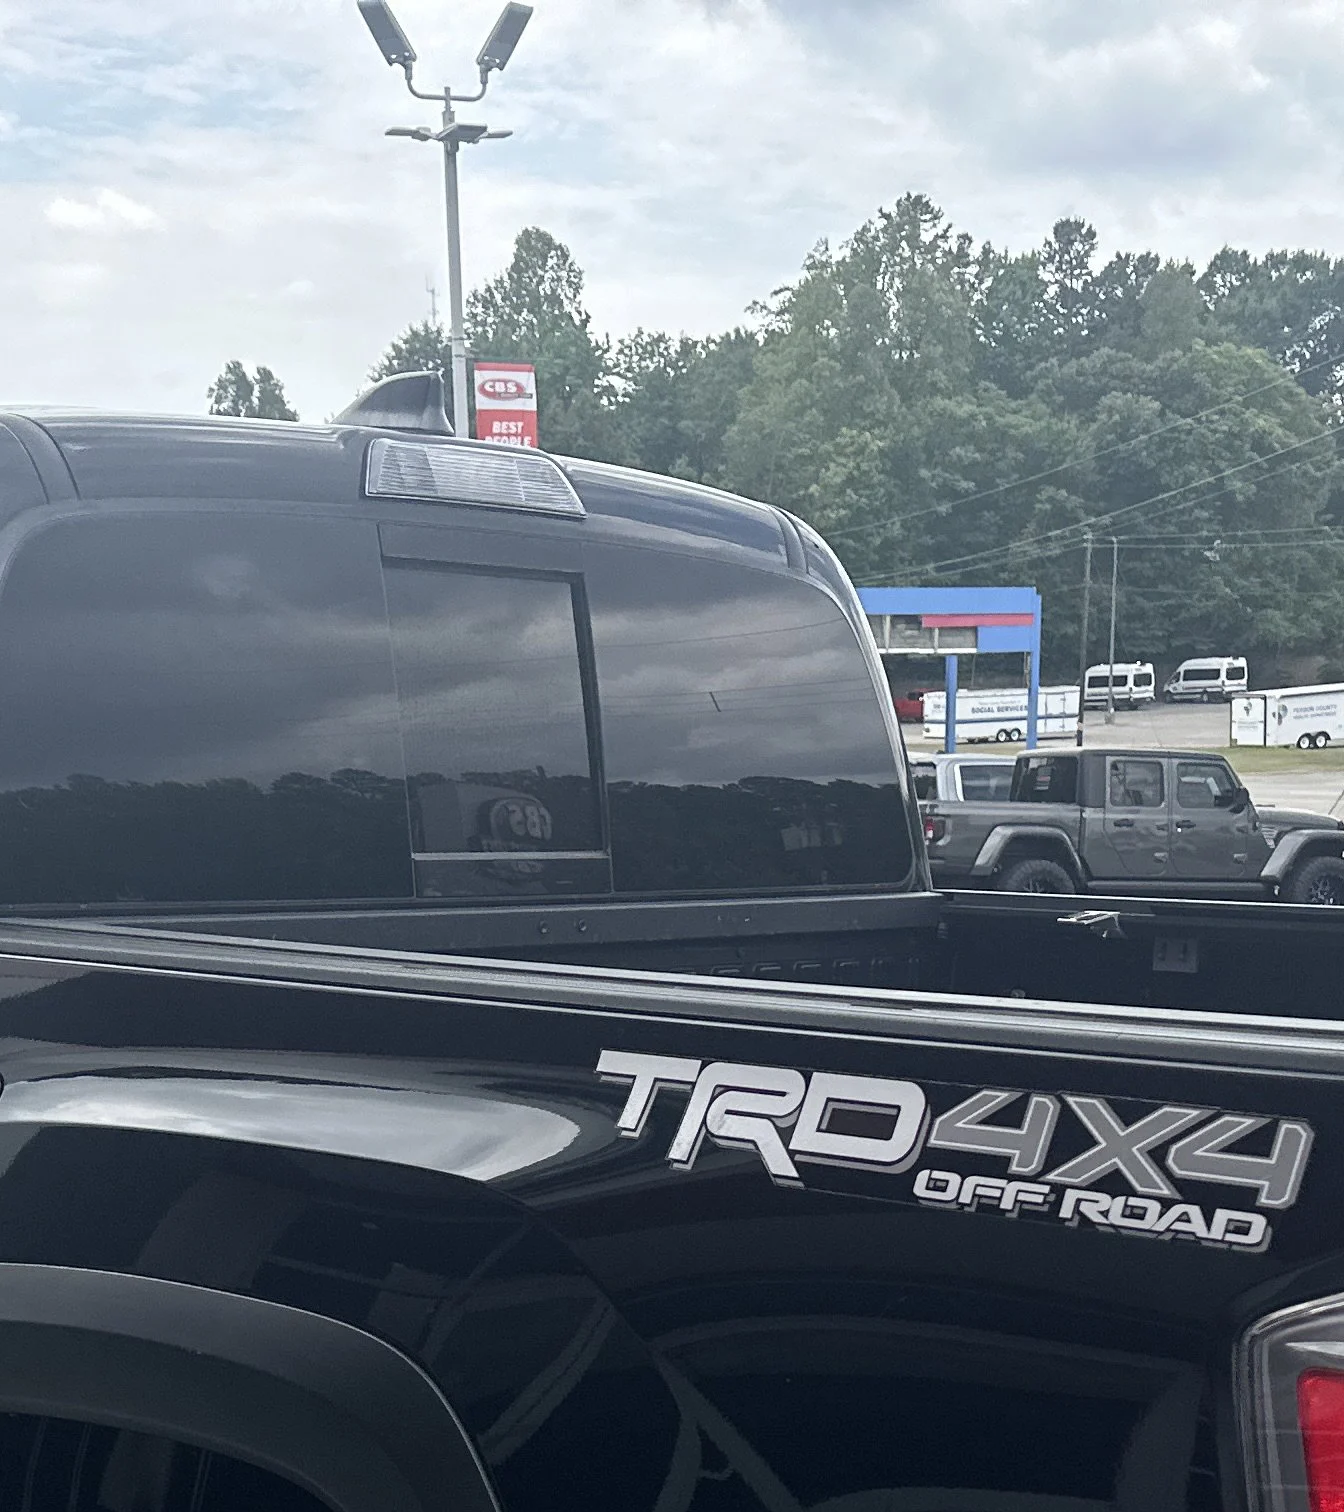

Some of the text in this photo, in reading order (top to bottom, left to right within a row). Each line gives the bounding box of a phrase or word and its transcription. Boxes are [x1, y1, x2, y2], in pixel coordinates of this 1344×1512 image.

[483, 381, 517, 393] CBS
[492, 421, 524, 434] BEST
[595, 1049, 1315, 1209] TRD 4X4
[912, 1167, 1272, 1253] OFF ROAD
